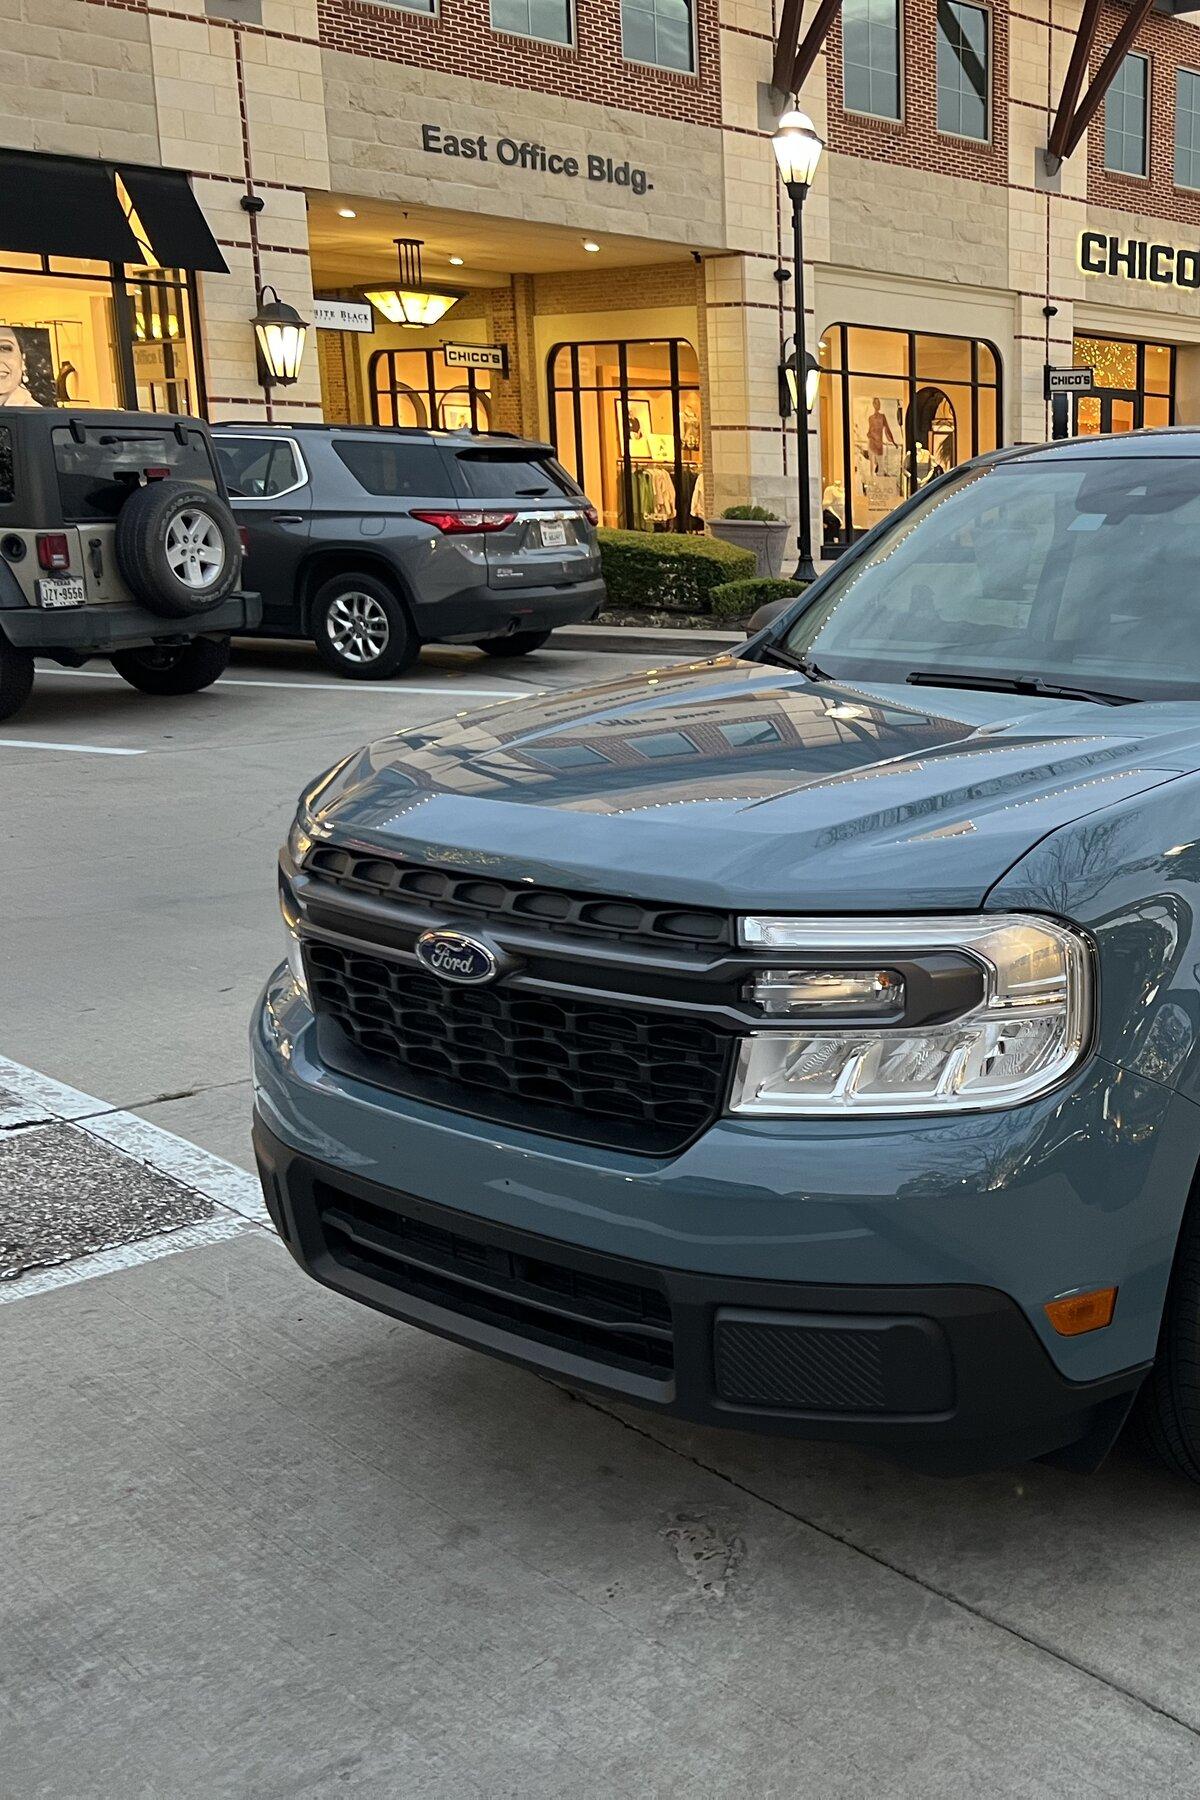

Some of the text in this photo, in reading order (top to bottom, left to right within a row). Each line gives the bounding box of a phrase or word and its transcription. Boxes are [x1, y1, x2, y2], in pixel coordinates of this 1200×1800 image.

[421, 123, 654, 195] East Office Bldg.
[448, 350, 501, 364] CHICO'S
[1050, 374, 1091, 386] CHICO'S
[431, 941, 474, 974] Ford
